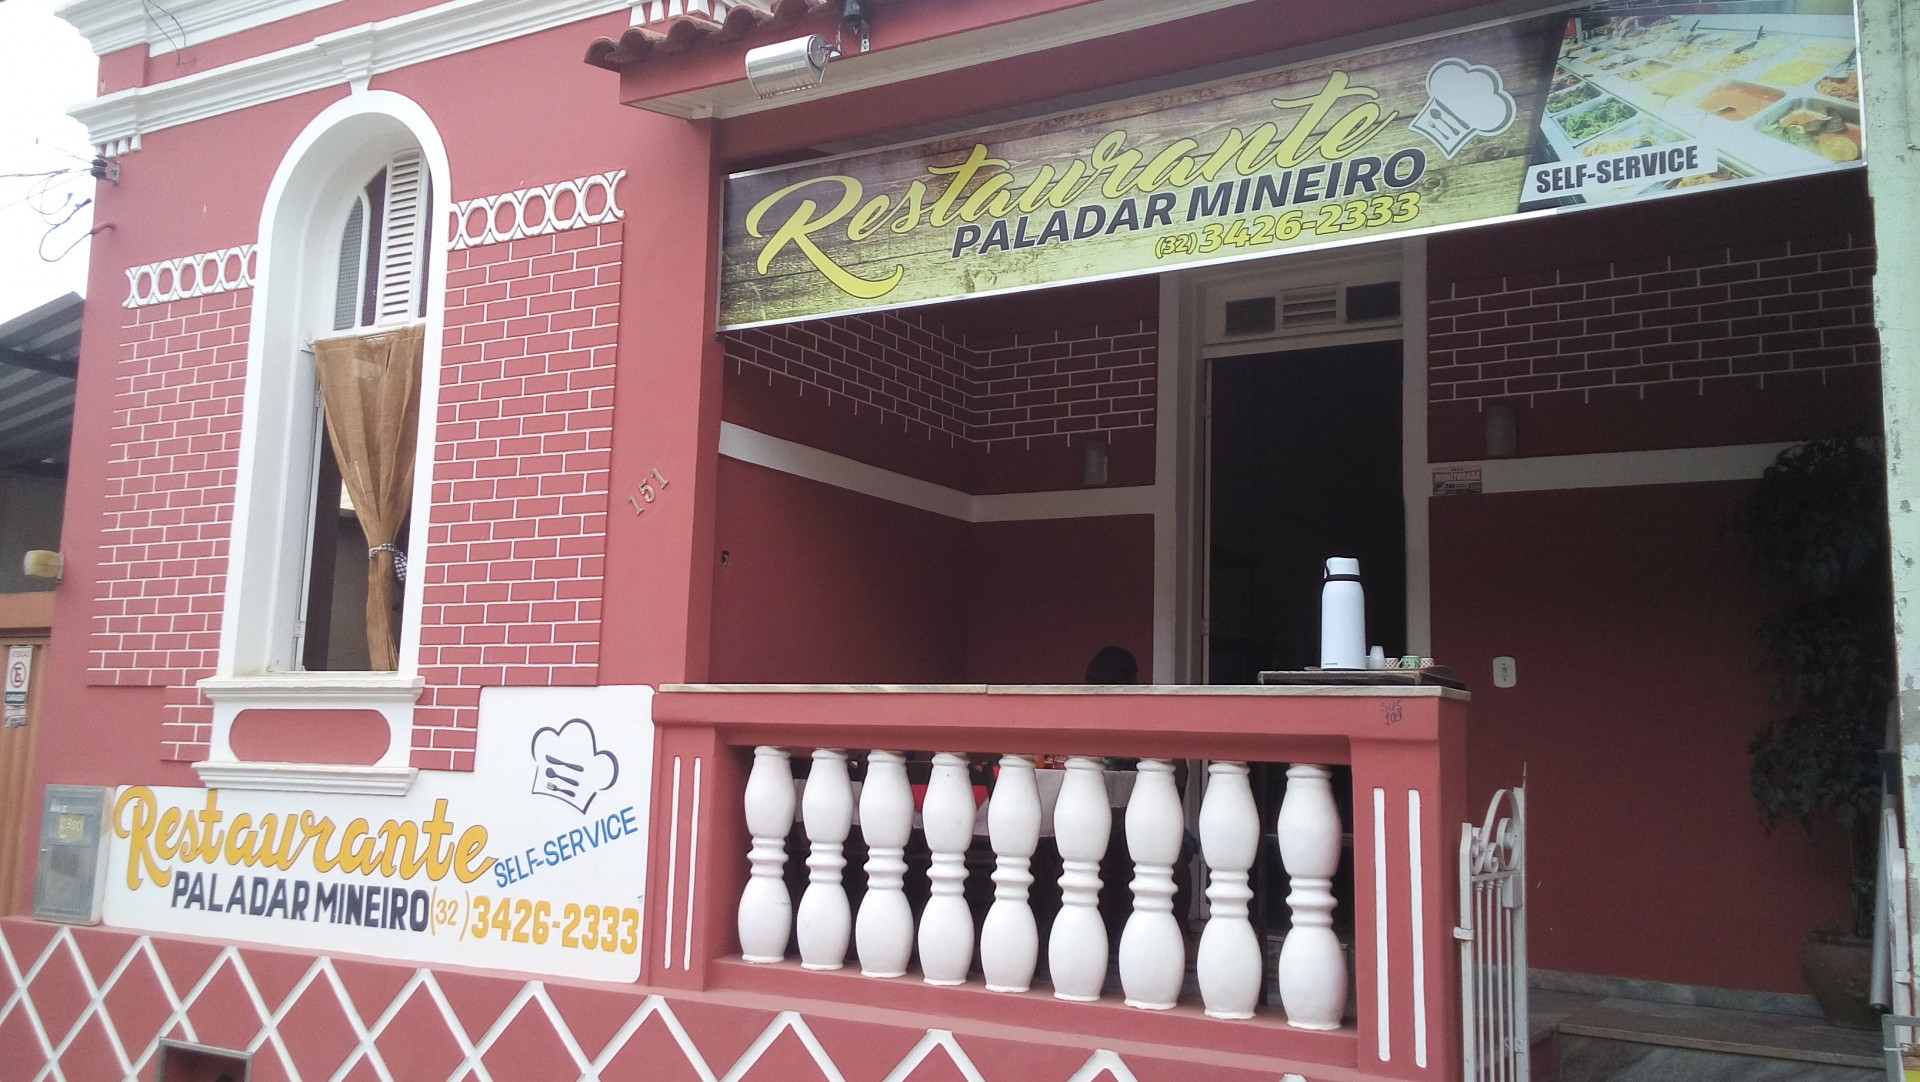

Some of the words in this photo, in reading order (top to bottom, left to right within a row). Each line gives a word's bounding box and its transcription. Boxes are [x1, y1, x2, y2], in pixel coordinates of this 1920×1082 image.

[745, 70, 1400, 299] Restaurante
[951, 191, 1174, 259] PALADAR
[1186, 148, 1426, 223] MINEIRO
[1536, 145, 1699, 194] SELF-SERVICE
[628, 467, 669, 516] 151
[113, 786, 499, 890] Restaurante
[494, 806, 639, 888] SELF-SERVICE
[171, 870, 309, 922] PALADAR
[313, 882, 429, 932] MINEIRO
